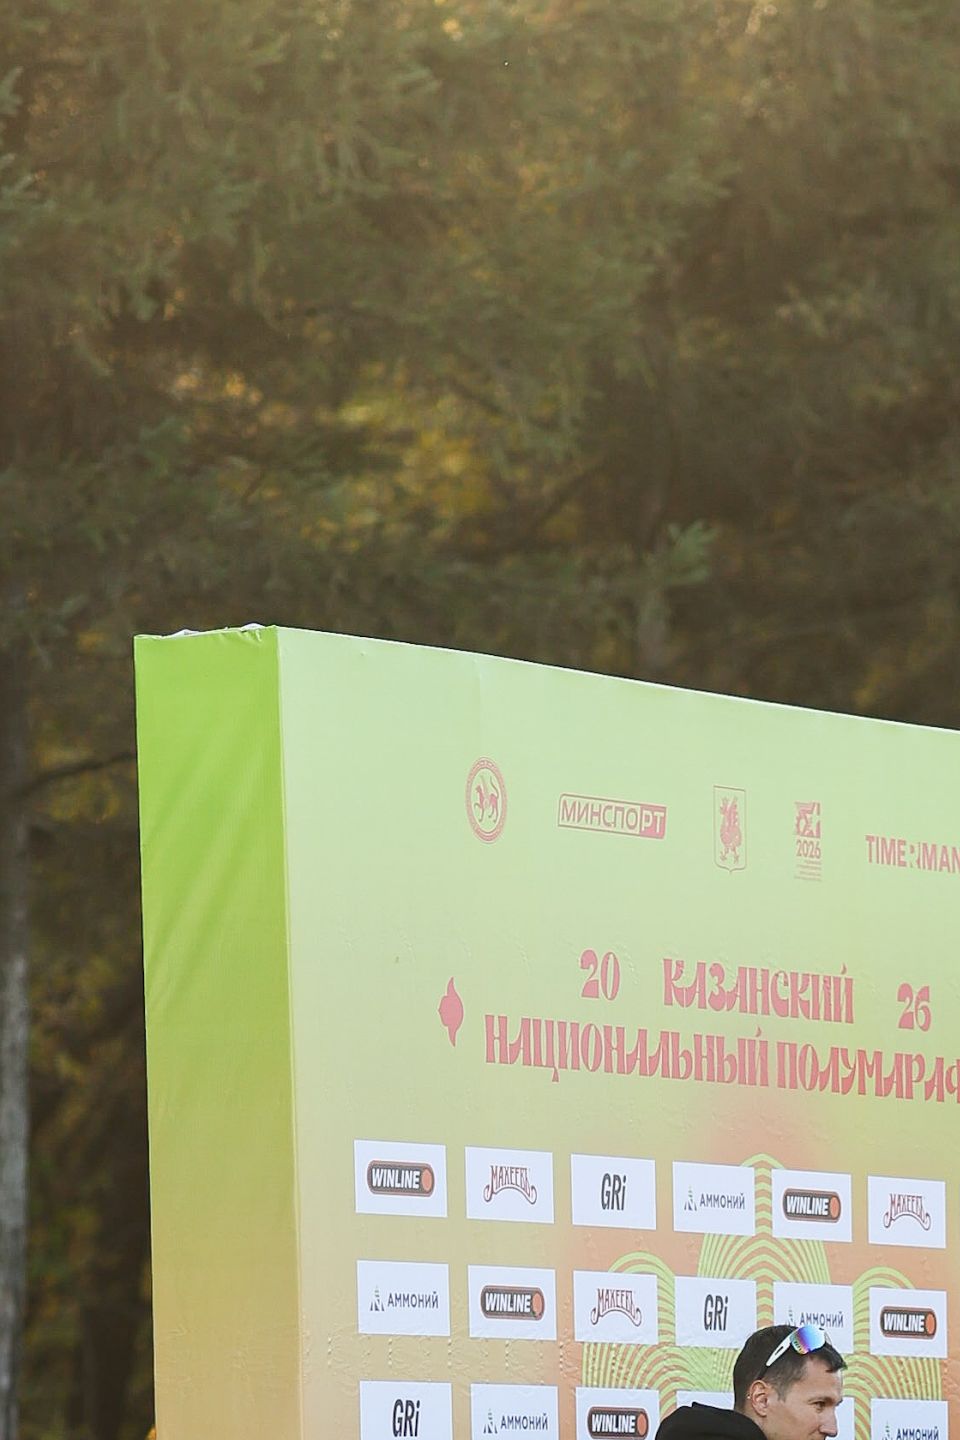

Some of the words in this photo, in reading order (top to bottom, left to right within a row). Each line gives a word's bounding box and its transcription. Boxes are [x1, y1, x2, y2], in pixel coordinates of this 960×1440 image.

[560, 799, 664, 834] МИНСПОРТ
[796, 839, 821, 859] 2026
[579, 948, 620, 1001] 20
[663, 958, 854, 1024] КАЗАНСКИЙ
[897, 982, 931, 1032] 26
[485, 1014, 769, 1087] НАЦИОНАЛЬНЫЙ
[372, 1170, 419, 1189] WINLINE
[601, 1173, 626, 1210] GRi
[700, 1192, 745, 1209] АММОНИЙ
[786, 1196, 828, 1215] WINLINE
[388, 1291, 438, 1308] АММОНИЙ
[485, 1293, 531, 1313] WINLINE
[704, 1295, 728, 1331] GRi
[800, 1310, 844, 1327] АММОНИЙ
[884, 1314, 924, 1332] WINLINE
[392, 1399, 420, 1437] GRi
[501, 1413, 548, 1430] АММОНИЙ
[592, 1414, 635, 1433] WINLINE
